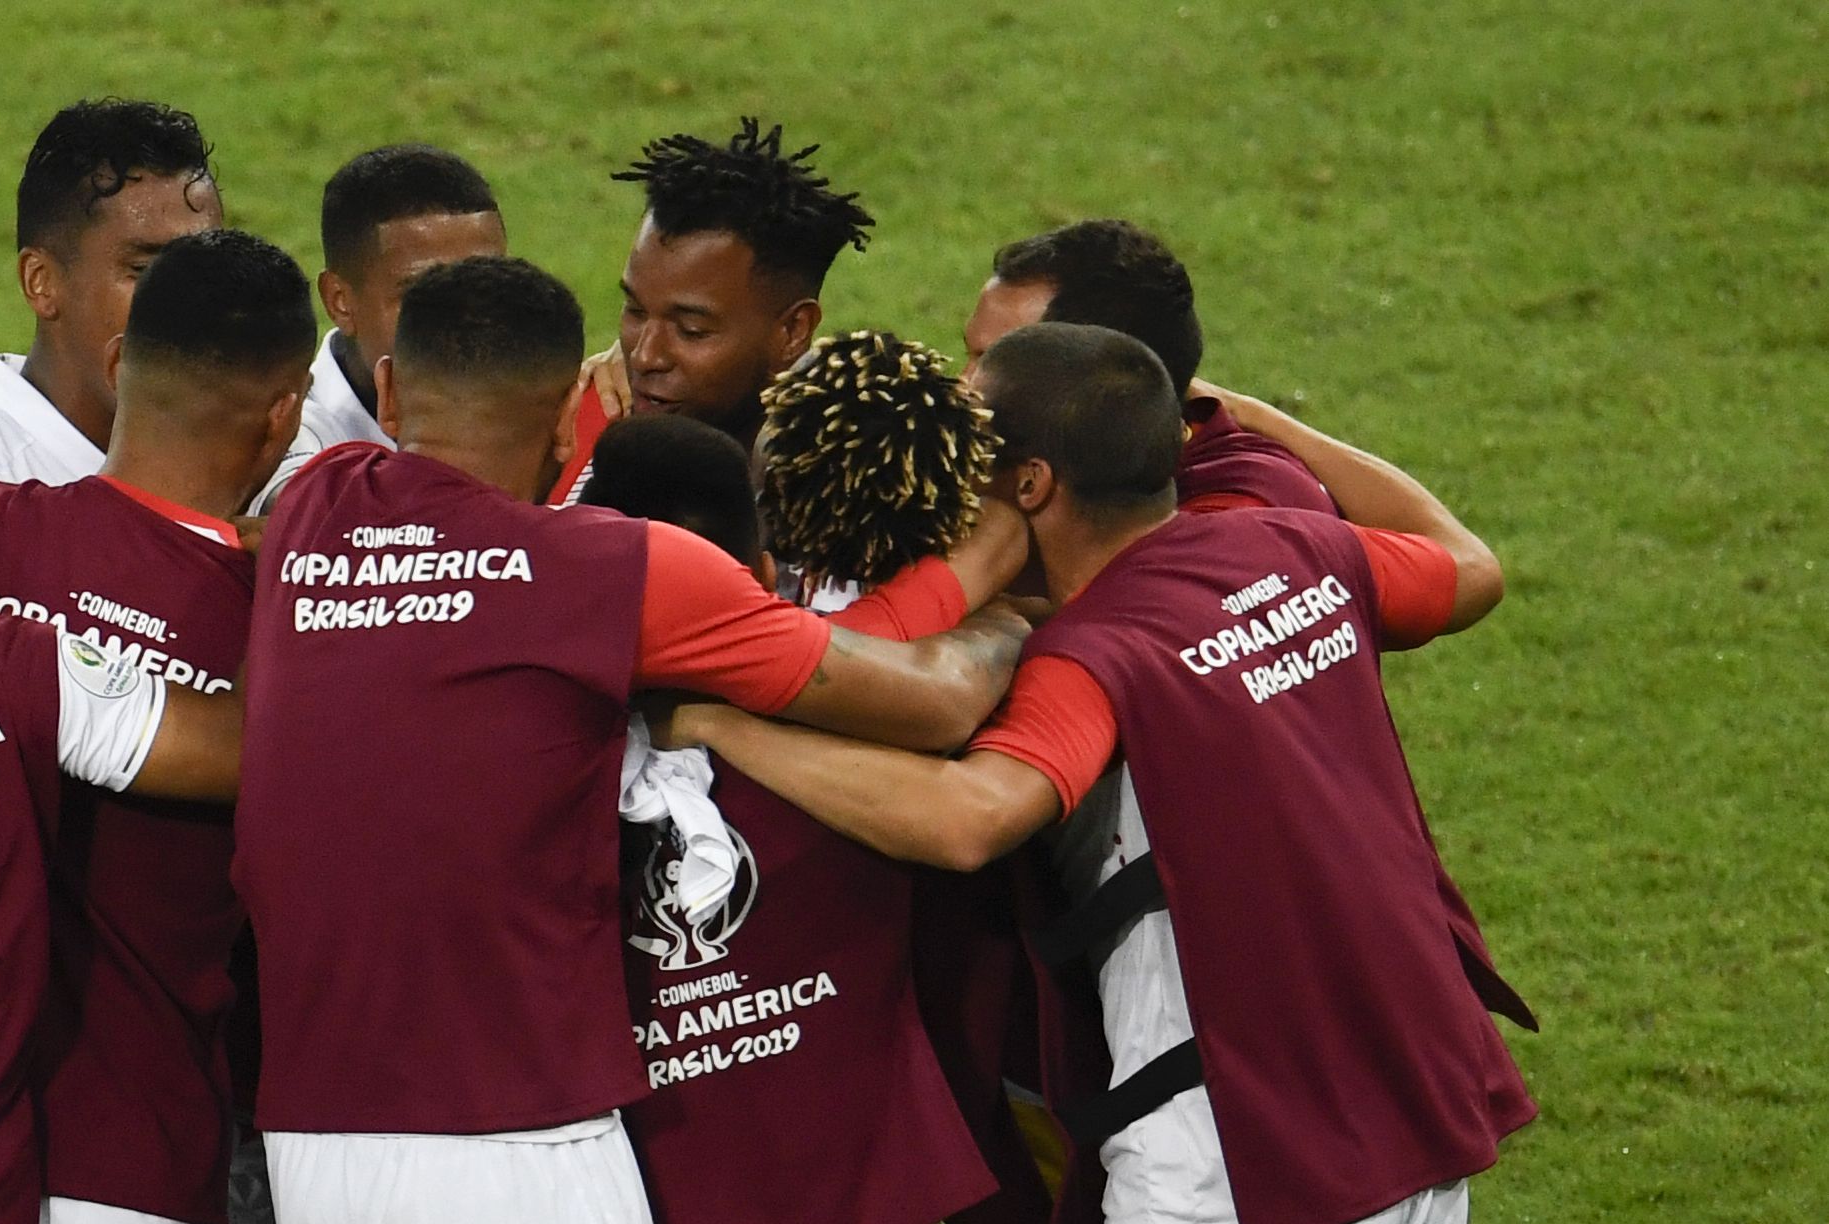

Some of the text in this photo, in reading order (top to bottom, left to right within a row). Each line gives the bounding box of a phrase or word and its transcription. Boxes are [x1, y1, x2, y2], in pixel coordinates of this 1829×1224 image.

[281, 549, 533, 586] COPA AMERICA
[394, 591, 474, 623] 2019
[1308, 621, 1358, 671] 2019
[632, 972, 838, 1050] PA AMERICA
[731, 1022, 800, 1063] 2019
